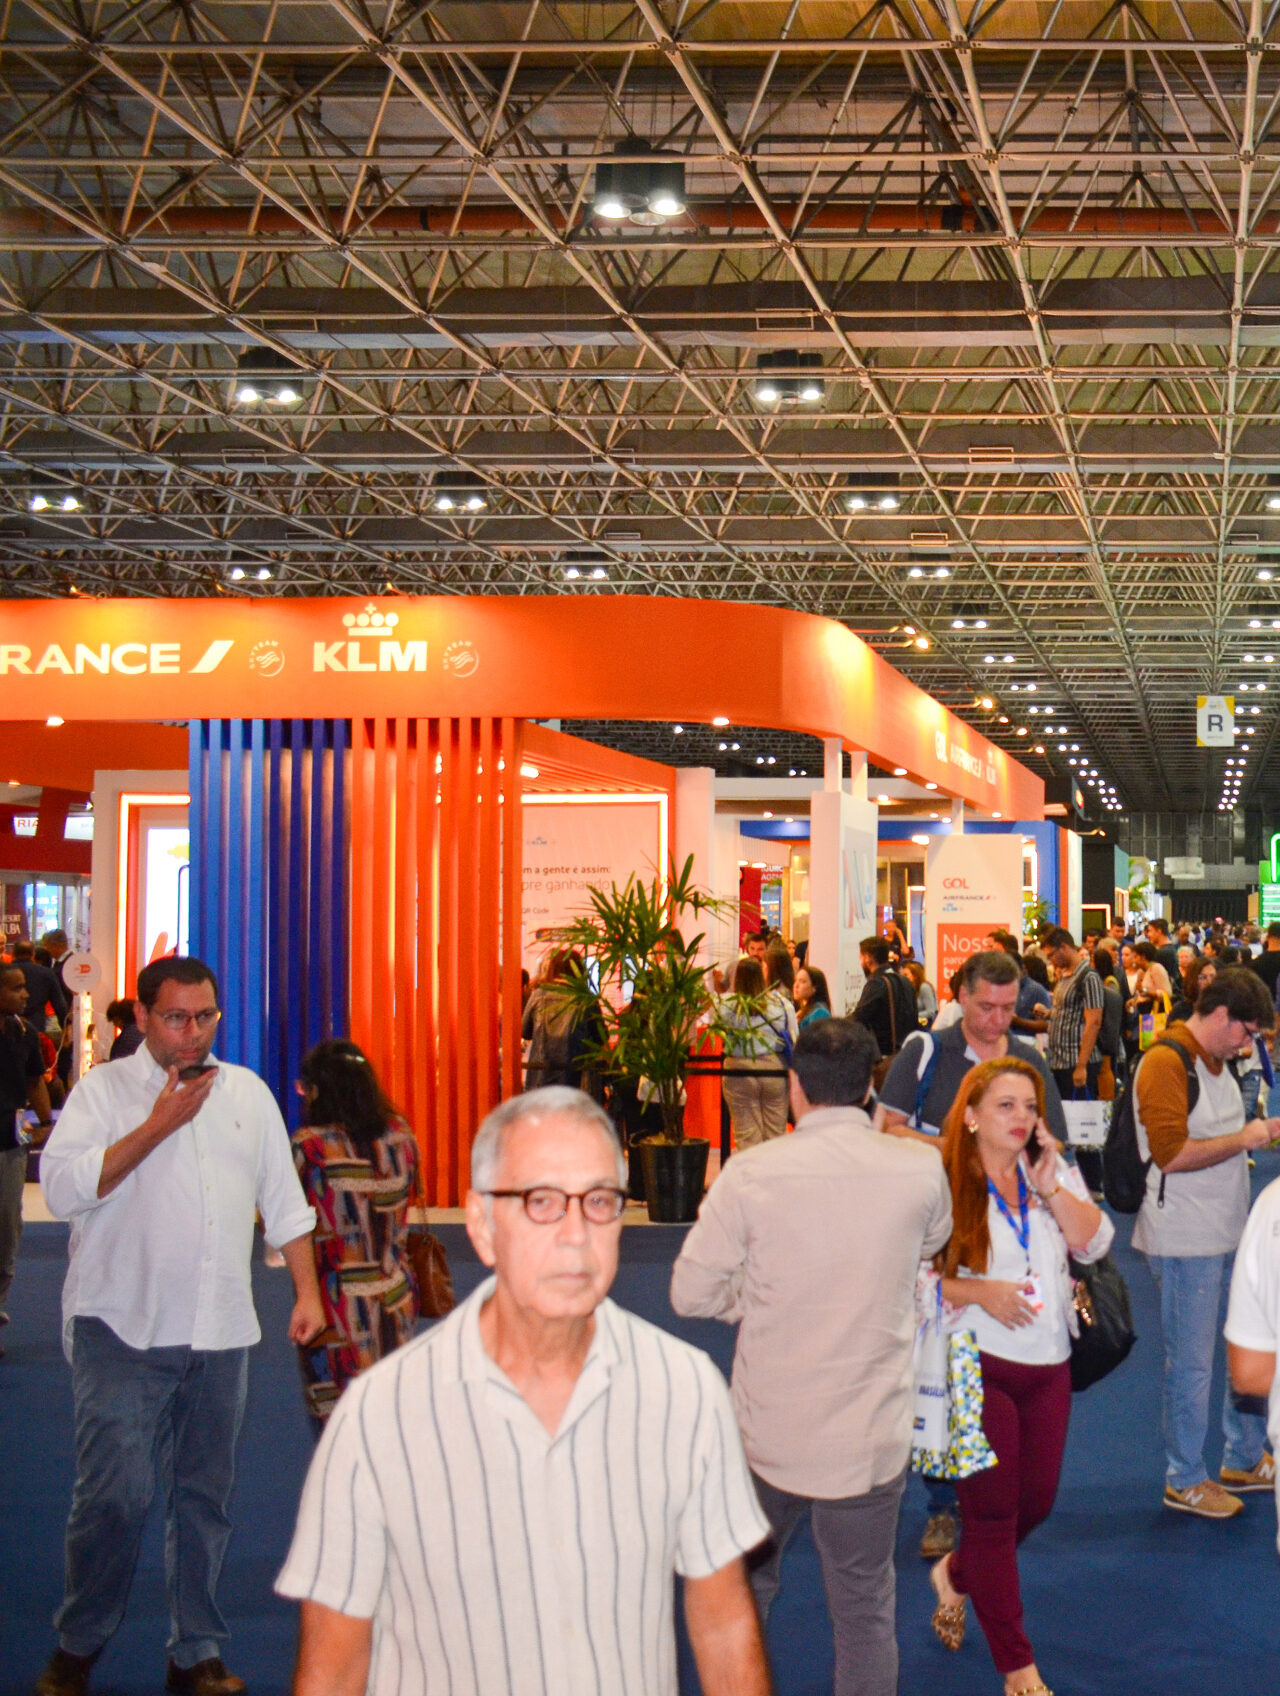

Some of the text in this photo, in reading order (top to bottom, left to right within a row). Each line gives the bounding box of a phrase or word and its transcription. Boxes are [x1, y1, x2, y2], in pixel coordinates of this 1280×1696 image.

[0, 642, 181, 675] RANCE
[313, 640, 428, 672] KLM
[1207, 714, 1224, 732] R
[942, 878, 969, 889] GOL
